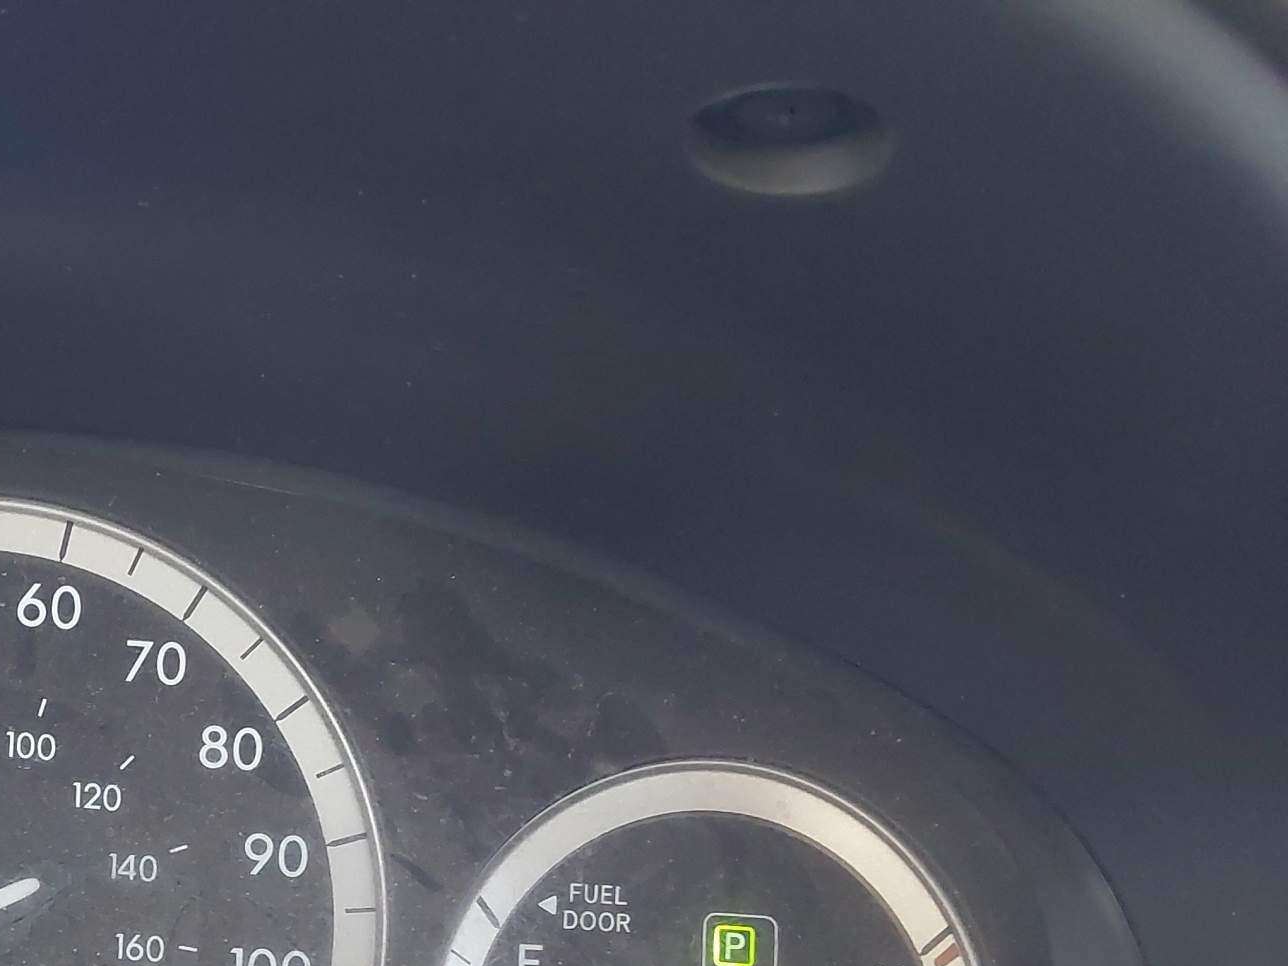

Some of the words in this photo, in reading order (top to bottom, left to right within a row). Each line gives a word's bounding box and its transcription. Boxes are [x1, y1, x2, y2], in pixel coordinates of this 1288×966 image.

[18, 584, 81, 629] 60
[126, 640, 185, 685] 70
[7, 732, 55, 760] 100
[200, 726, 262, 770] 80
[73, 782, 121, 811] 120
[109, 854, 157, 881] 140
[245, 833, 308, 877] 90
[570, 883, 627, 905] FUEL
[564, 910, 630, 932] DOOR
[116, 934, 164, 962] 160
[725, 932, 745, 959] P
